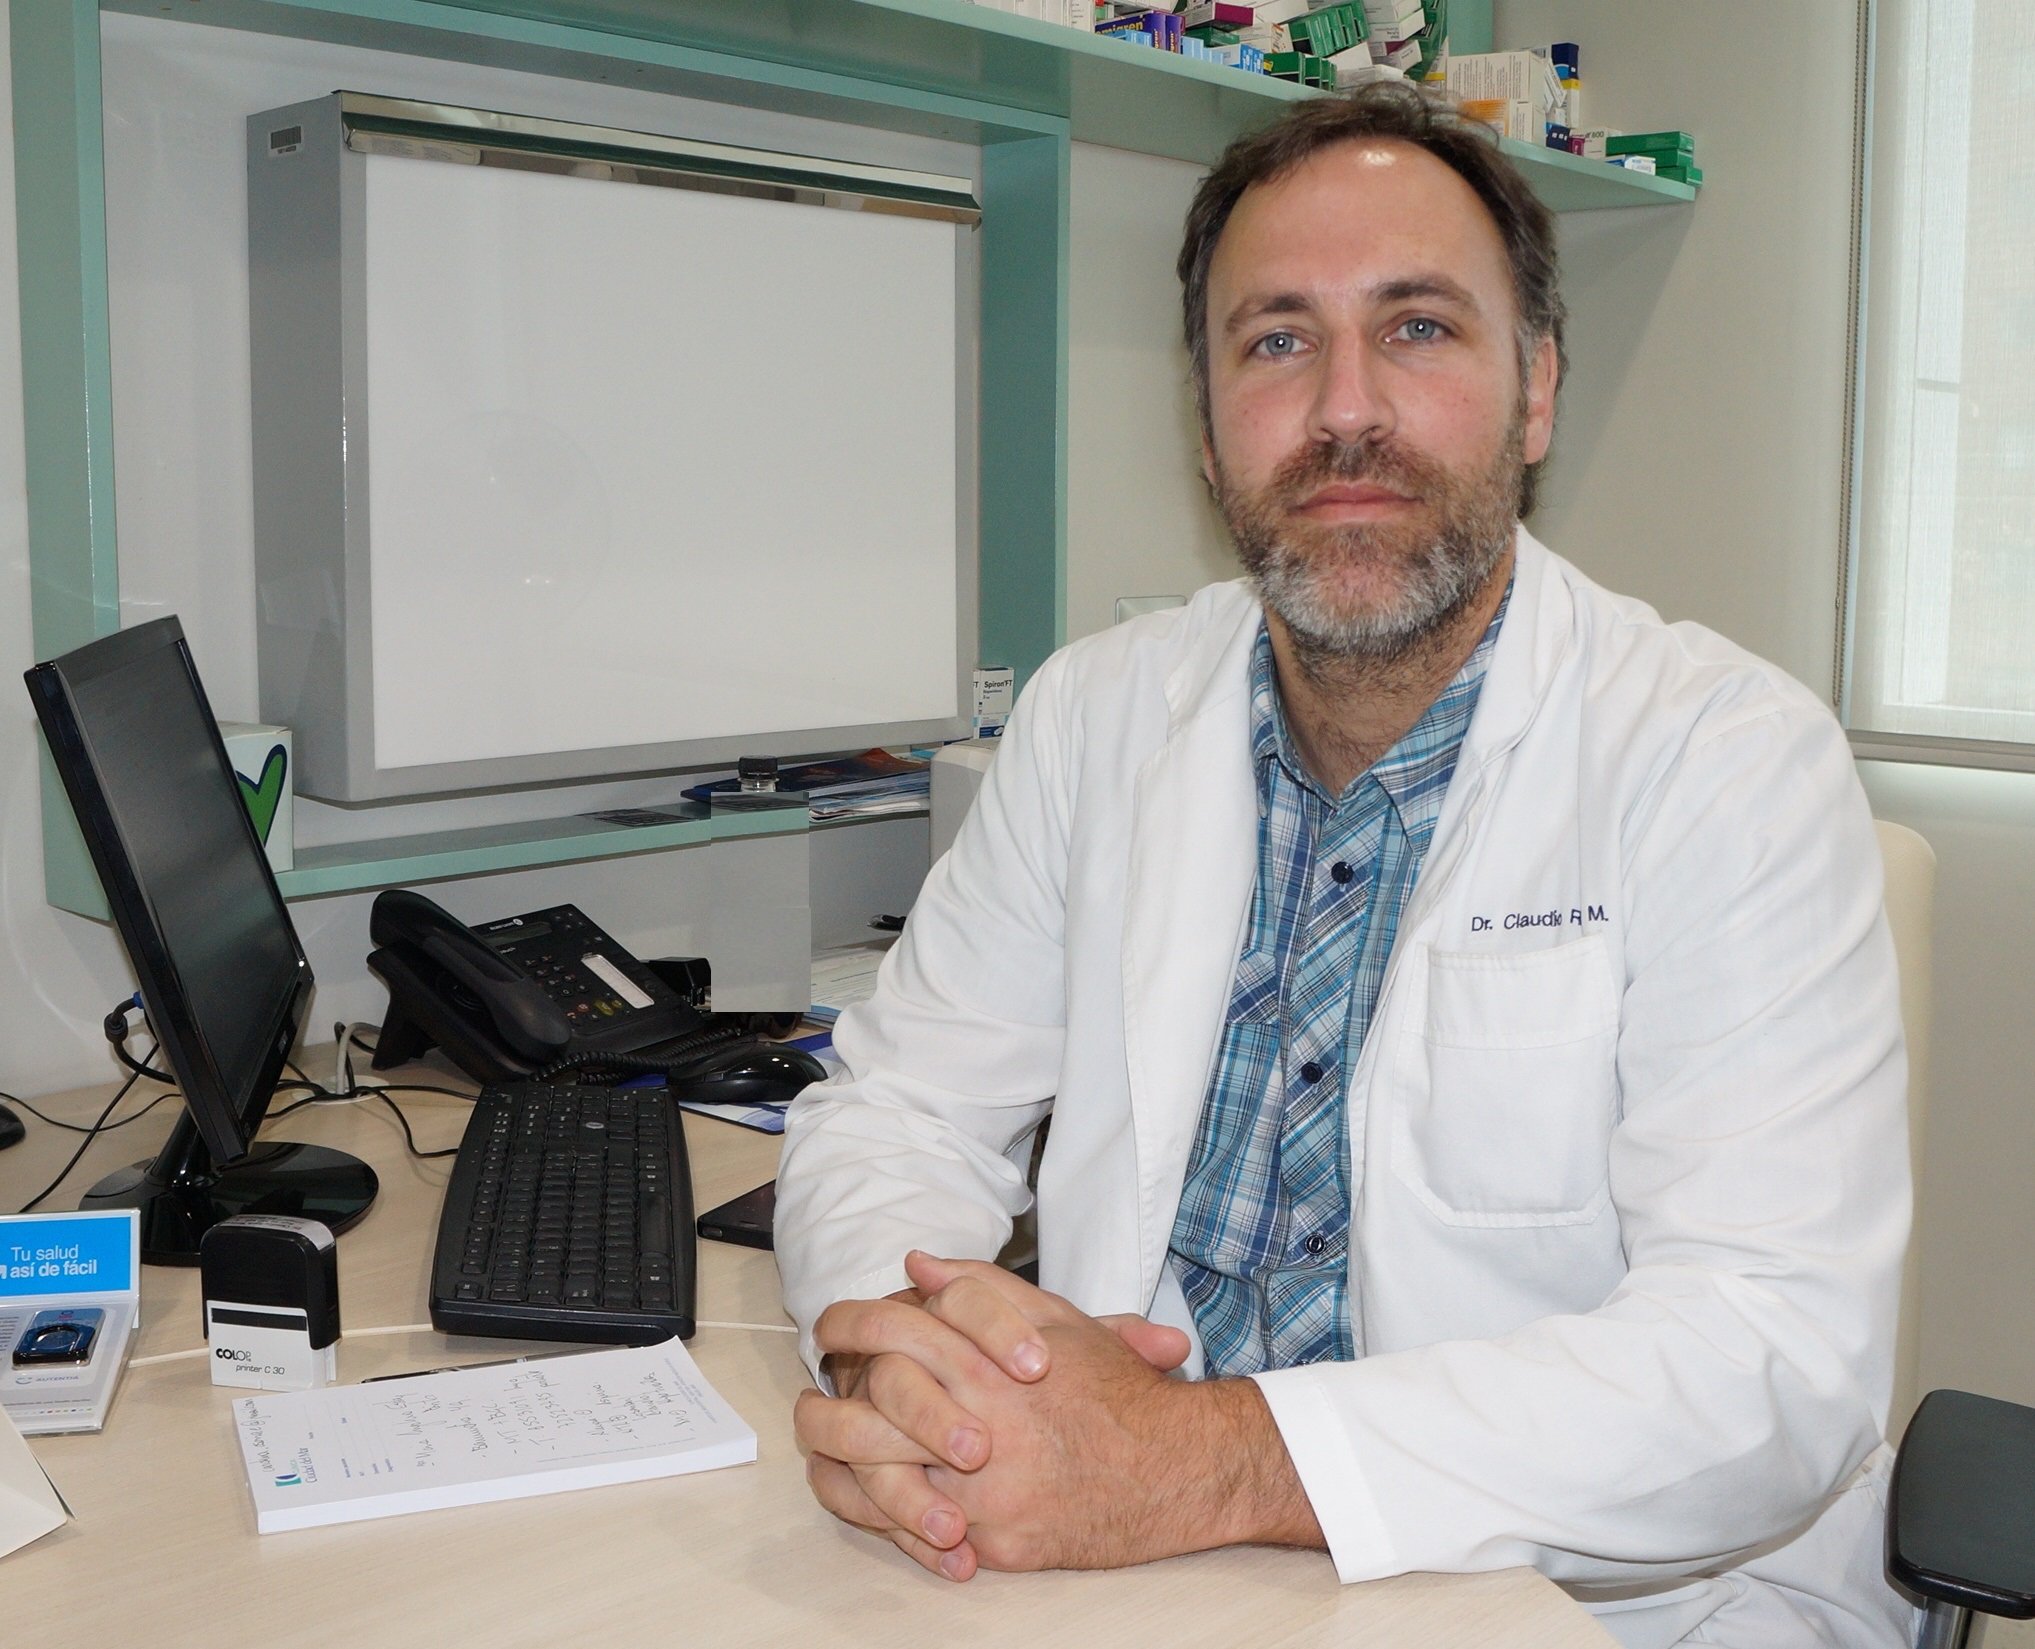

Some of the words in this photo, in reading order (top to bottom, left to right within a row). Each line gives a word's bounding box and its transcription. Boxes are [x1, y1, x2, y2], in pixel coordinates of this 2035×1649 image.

[1471, 916, 1493, 932] Dr.
[1588, 904, 1609, 922] M.
[10, 1246, 31, 1262] Tu
[36, 1243, 79, 1260] salud
[10, 1262, 35, 1279] así
[38, 1262, 60, 1277] de
[63, 1258, 98, 1276] fácil
[236, 1365, 262, 1373] printer
[264, 1365, 271, 1374] C
[272, 1366, 285, 1375] 30
